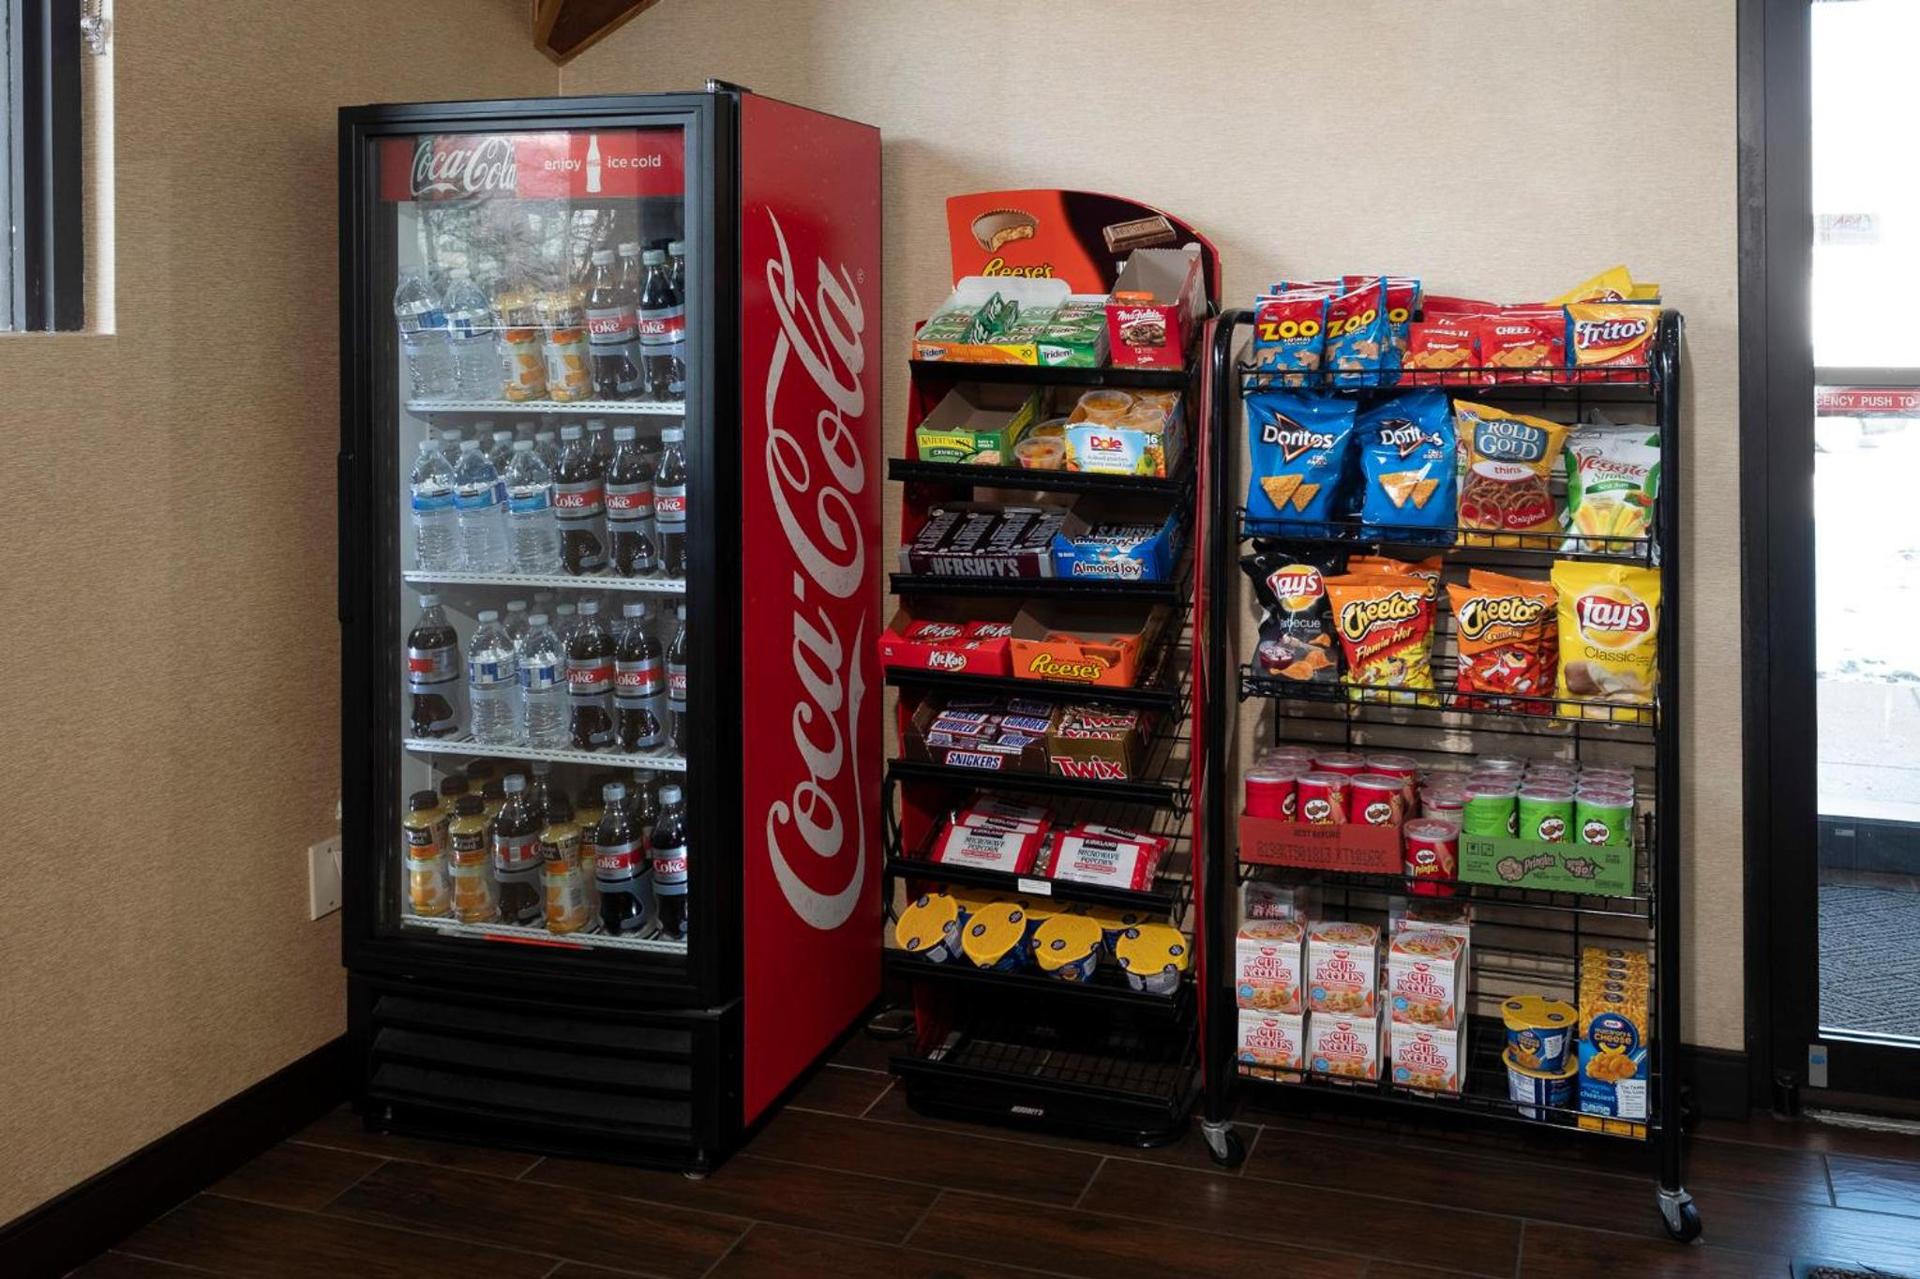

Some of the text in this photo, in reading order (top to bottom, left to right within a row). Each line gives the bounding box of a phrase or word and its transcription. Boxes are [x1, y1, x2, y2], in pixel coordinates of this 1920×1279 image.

[411, 136, 517, 196] Coca-Cola
[544, 157, 581, 170] enjoy
[607, 154, 662, 168] ice cold
[982, 258, 1053, 278] Reese's
[588, 320, 620, 334] Coke
[1258, 319, 1320, 341] ZOO
[1326, 309, 1376, 338] ZOO
[1575, 319, 1646, 349] Fritos
[1042, 350, 1074, 359] Trident
[1861, 396, 1893, 406] PUSH
[1898, 396, 1915, 406] TO
[1146, 434, 1159, 445] 16
[1262, 424, 1334, 448] Doritos
[1487, 421, 1540, 442] ROLD
[1090, 435, 1123, 449] Dole
[1479, 434, 1539, 460] GOLD
[1494, 466, 1522, 475] thins
[1576, 451, 1649, 475] Veggie
[555, 494, 584, 507] Coke
[766, 205, 867, 930] Coca-Cola
[932, 557, 1020, 577] HERSHEY'S
[1073, 561, 1141, 575] Almond Joy
[1341, 590, 1420, 641] Cheetos
[1580, 597, 1646, 630] Lay's
[1392, 625, 1416, 643] Hot
[1584, 645, 1637, 662] Classic
[1028, 652, 1102, 680] Reese's
[948, 752, 1001, 769] SNICKERS
[1051, 755, 1127, 780] Twix
[652, 857, 686, 874] Coke
[1524, 853, 1556, 872] Pringles
[1255, 956, 1282, 968] CUP
[1327, 959, 1355, 971] CUP
[1243, 965, 1291, 980] NOODLES
[1316, 968, 1365, 984] NOODLES
[1407, 971, 1436, 984] CUP
[1397, 979, 1446, 998] NOODLES
[1256, 1027, 1284, 1039] CUP
[1330, 1030, 1358, 1042] CUP
[1246, 1034, 1293, 1051] NOODLES
[1319, 1039, 1368, 1056] NOODLES
[1411, 1041, 1439, 1054] CUP
[1399, 1048, 1448, 1069] NOODLES
